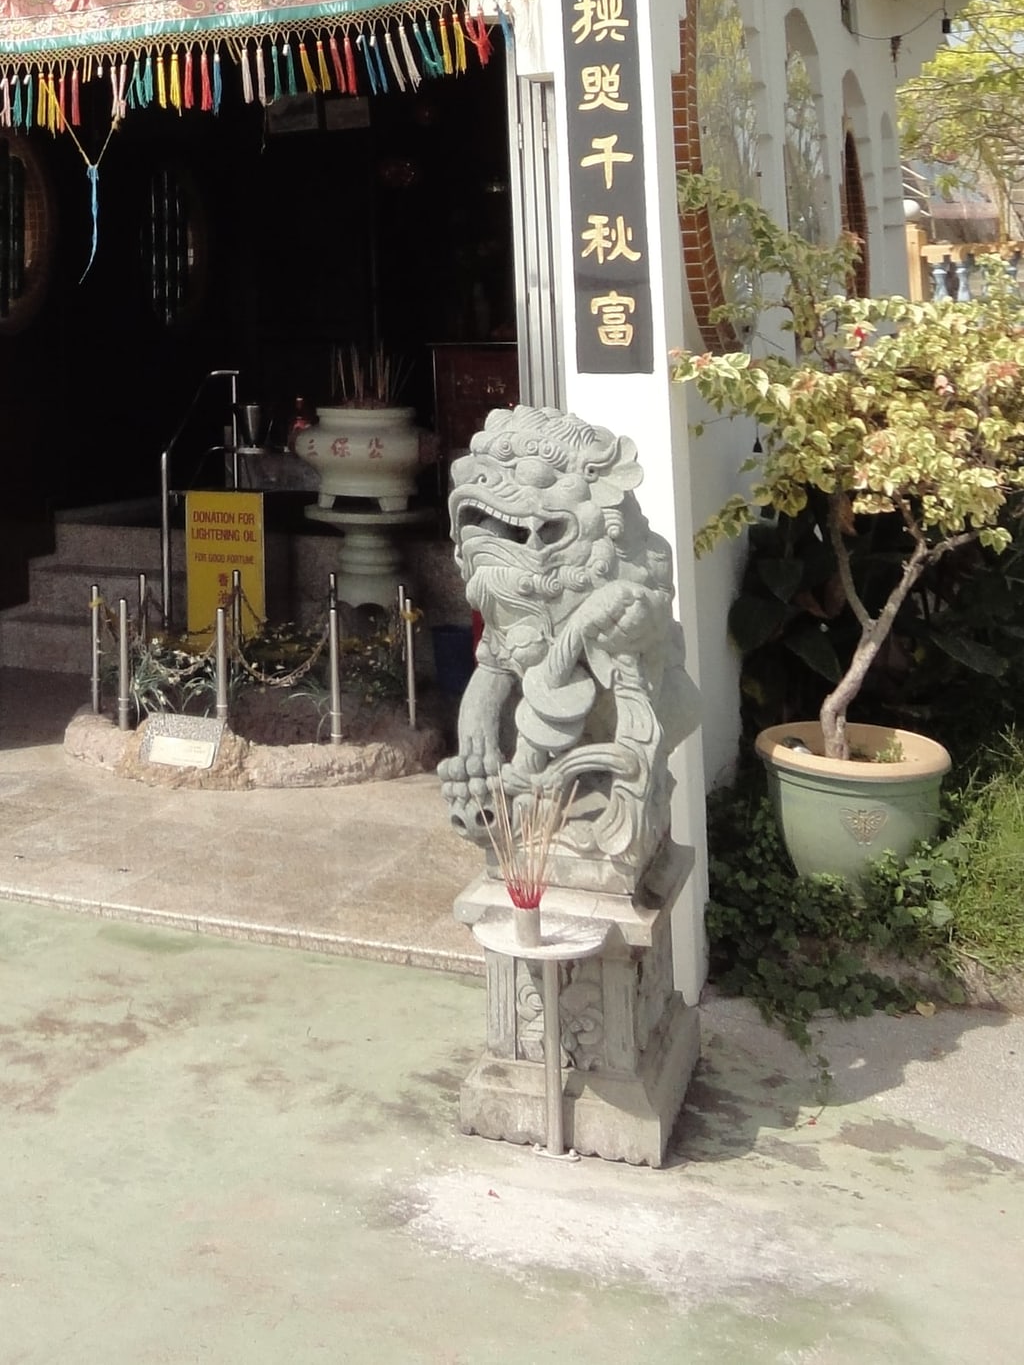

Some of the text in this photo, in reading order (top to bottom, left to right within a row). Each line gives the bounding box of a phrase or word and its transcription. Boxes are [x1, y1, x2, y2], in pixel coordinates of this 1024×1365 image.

[193, 511, 255, 525] DONATION FOR
[191, 528, 257, 542] LIGHTENING OIL
